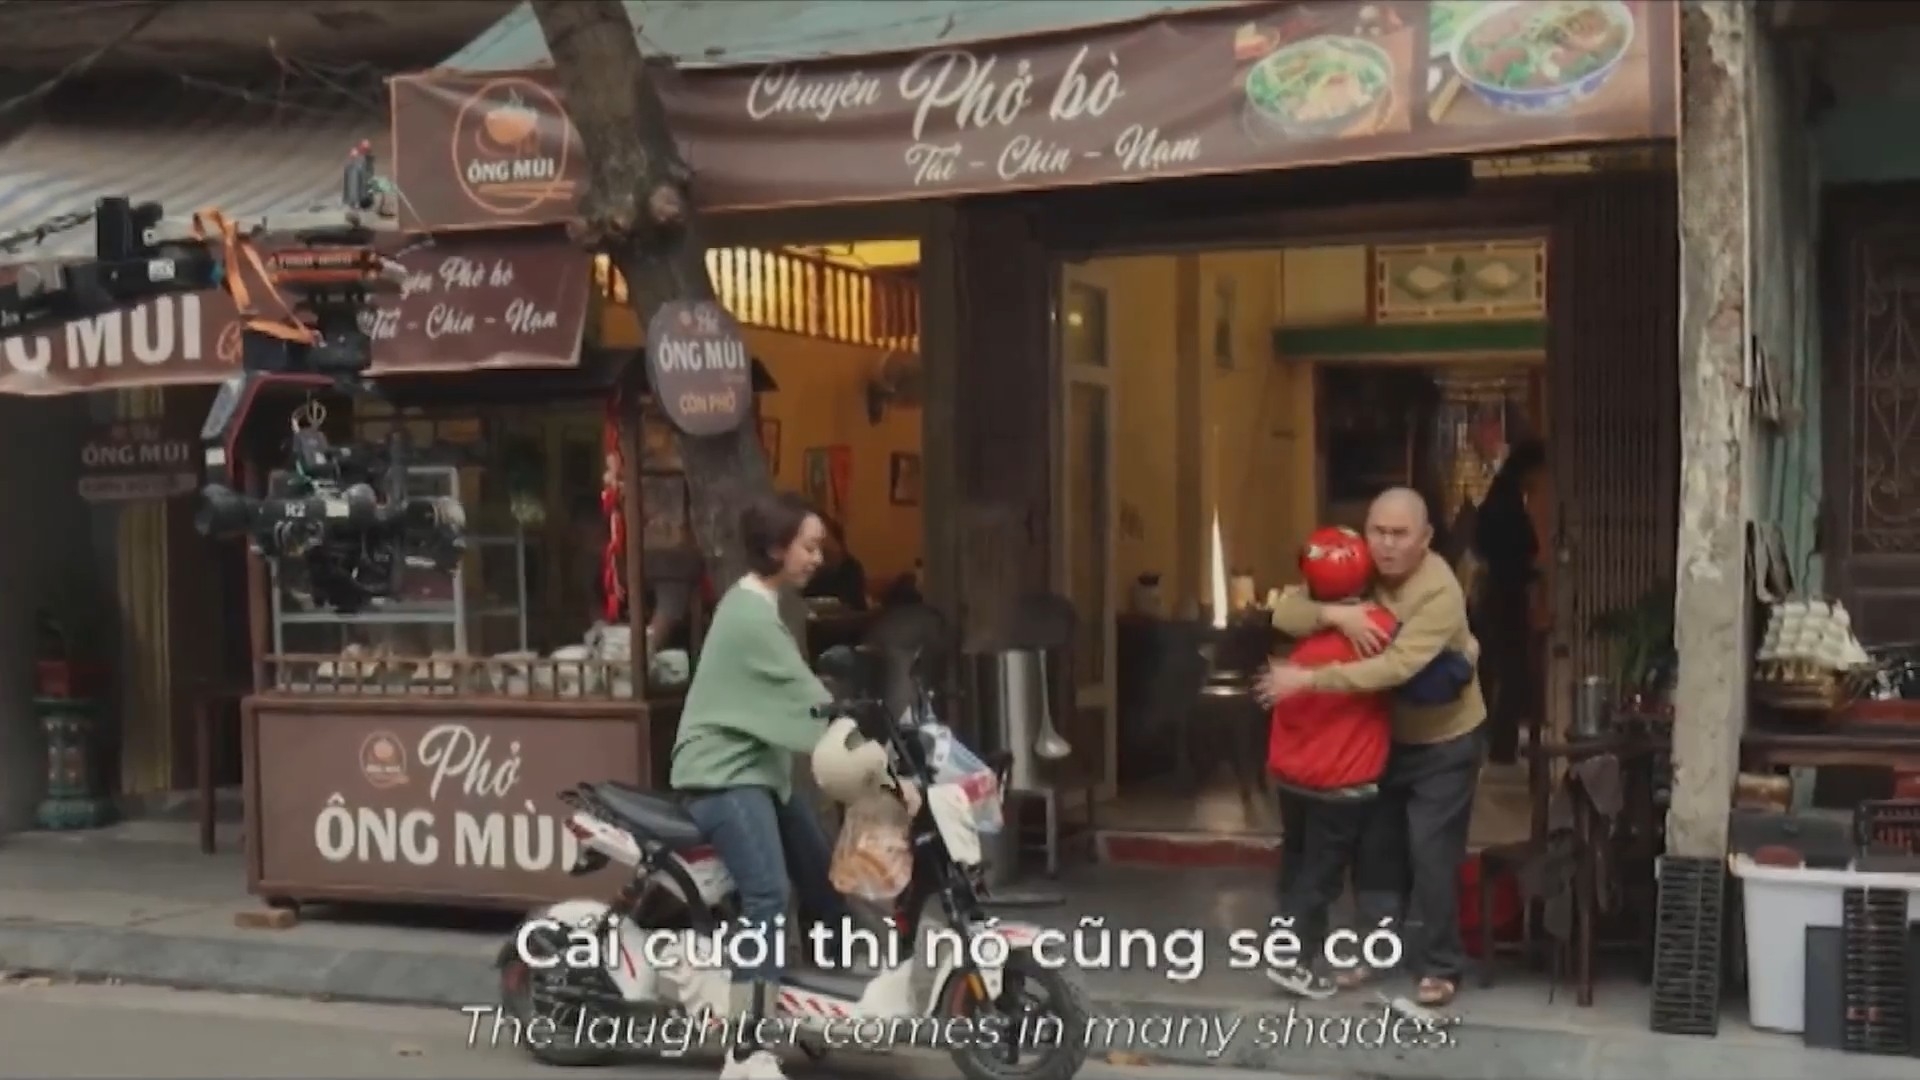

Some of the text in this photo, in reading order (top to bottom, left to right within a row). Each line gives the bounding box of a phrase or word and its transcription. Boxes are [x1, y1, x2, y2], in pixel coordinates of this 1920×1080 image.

[746, 43, 1126, 141] Chuyên Phở bò
[467, 158, 509, 184] ÔNG
[659, 334, 702, 372] ÔNG
[81, 441, 135, 466] ÔNG
[418, 724, 522, 801] Phở
[315, 791, 439, 866] ÔNG
